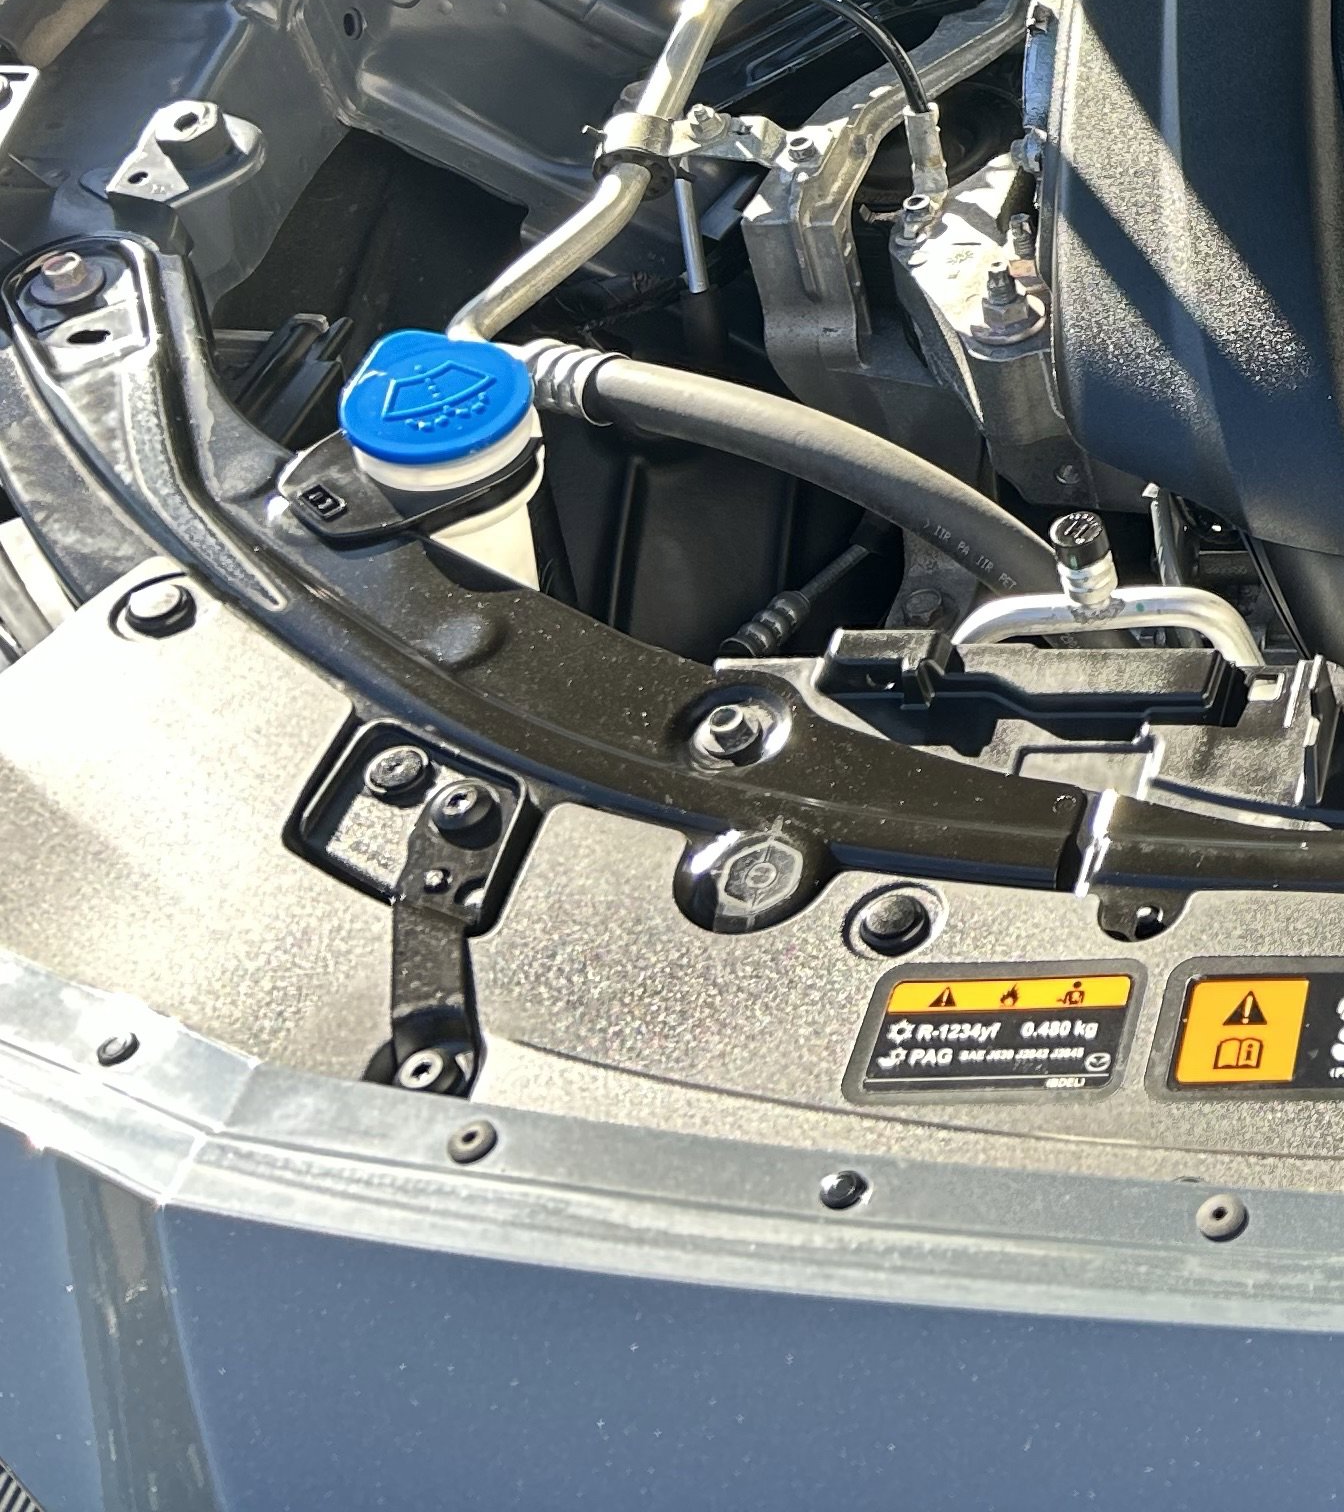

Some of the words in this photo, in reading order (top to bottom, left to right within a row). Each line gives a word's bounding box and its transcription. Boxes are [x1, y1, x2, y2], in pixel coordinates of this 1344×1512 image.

[998, 572, 1017, 590] PET
[916, 1021, 1001, 1042] R-1234yf
[1073, 1019, 1099, 1039] kg
[907, 1047, 953, 1065] PAG
[959, 1049, 986, 1061] SAE
